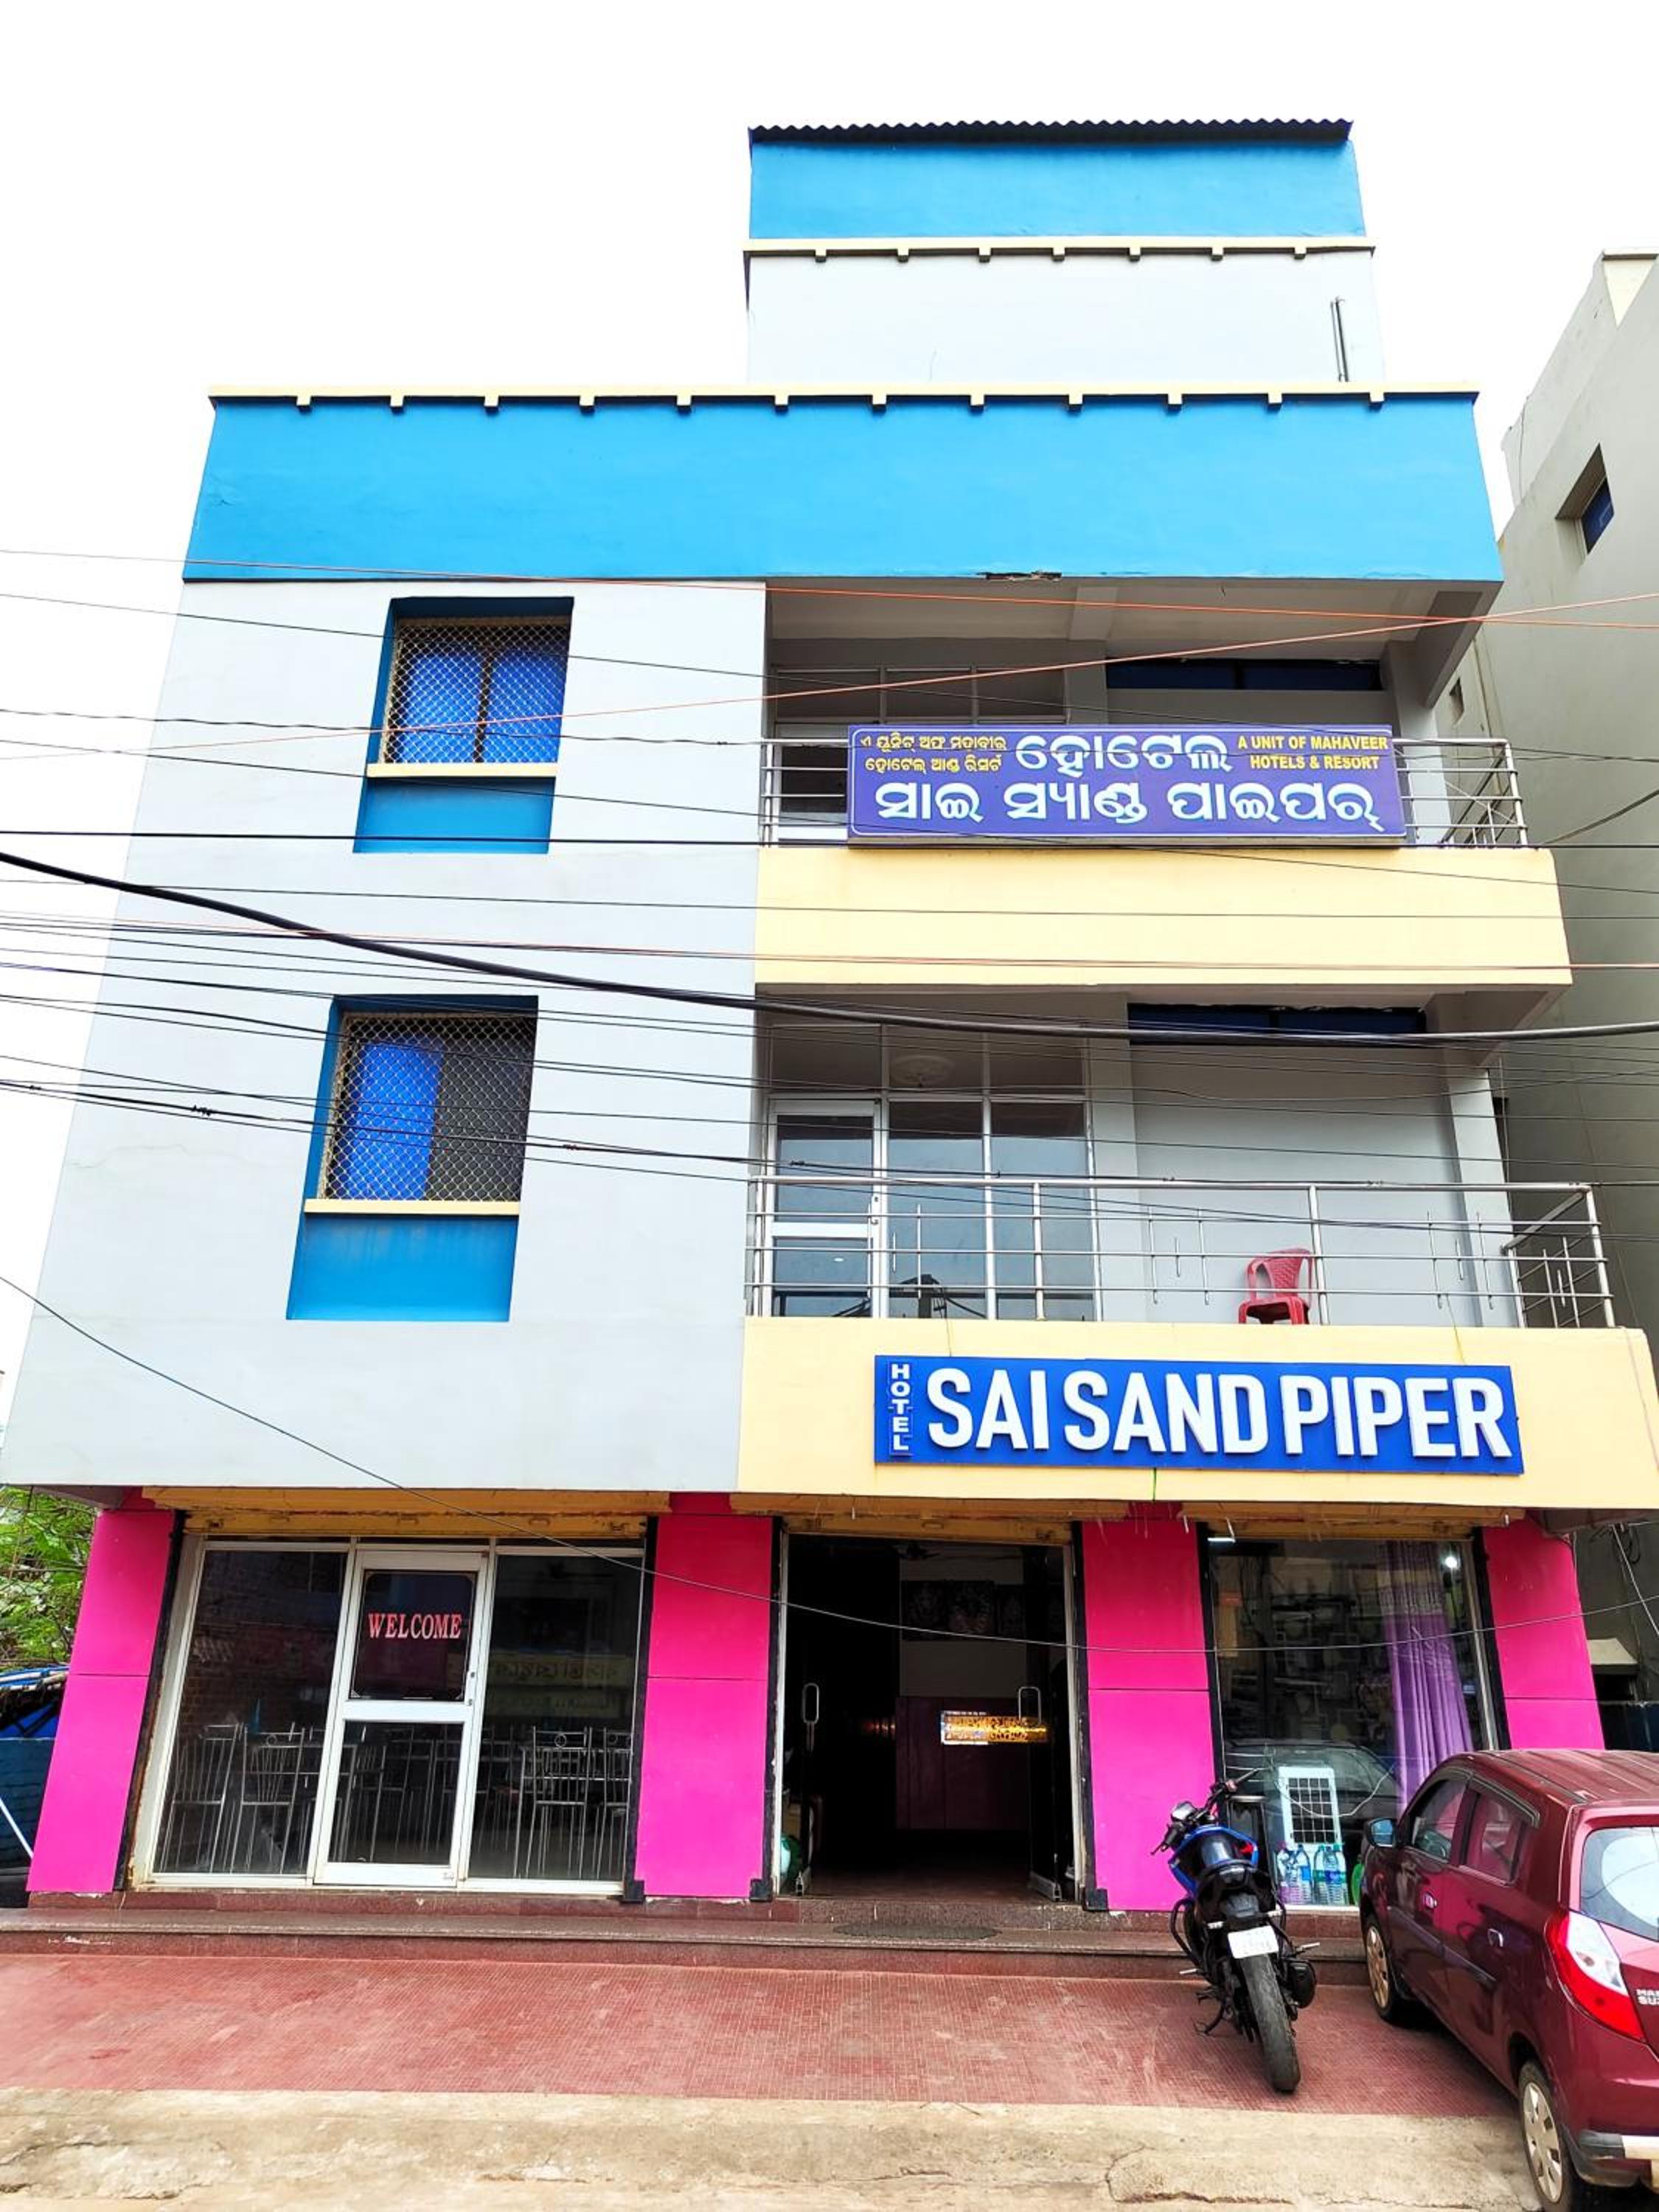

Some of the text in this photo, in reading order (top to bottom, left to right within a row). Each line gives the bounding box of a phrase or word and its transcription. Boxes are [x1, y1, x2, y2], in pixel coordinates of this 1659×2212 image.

[1238, 736, 1388, 750] A UNIT OF MAHAVEER
[1251, 755, 1380, 769] HOTELS & RESORT
[875, 782, 984, 822] ସାଇ
[1167, 782, 1385, 832] ପାଇପର୍
[891, 1363, 911, 1451] HOTEL
[926, 1368, 1512, 1457] SAI SAND PIPER
[369, 1613, 462, 1640] WELCOME
